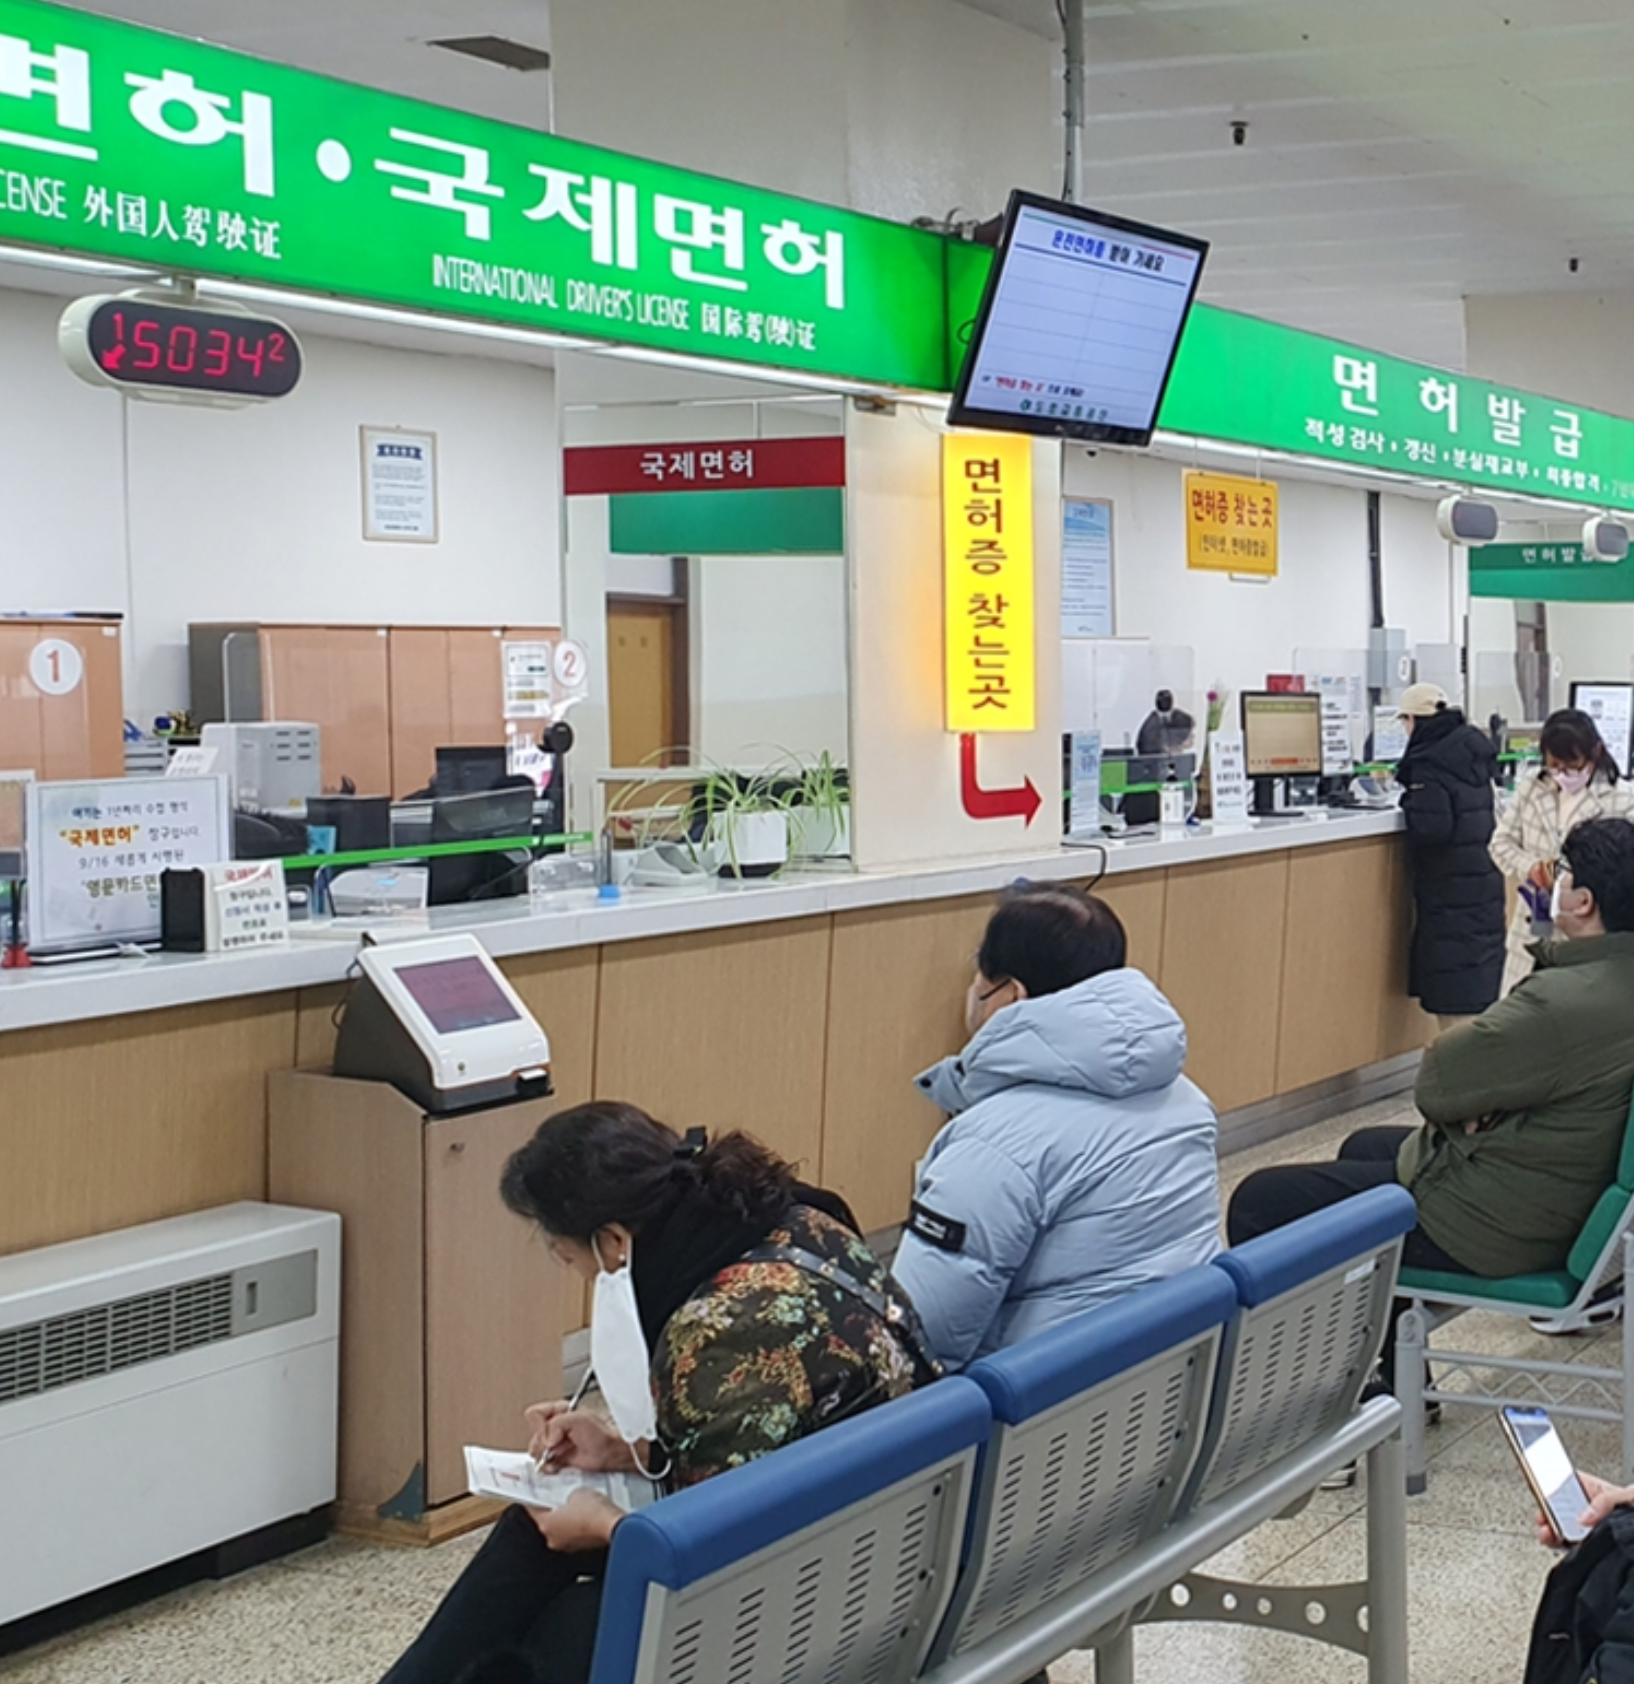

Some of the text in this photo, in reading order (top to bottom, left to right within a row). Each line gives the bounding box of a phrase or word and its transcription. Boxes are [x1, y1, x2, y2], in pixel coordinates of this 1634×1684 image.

[433, 254, 558, 308] INTERNATIONAL
[637, 294, 689, 330] LICENSE
[640, 449, 754, 481] 국제면허
[1404, 438, 1436, 464] 갱신
[963, 457, 1008, 576] 면허증
[1192, 489, 1229, 525] 면허증
[46, 651, 60, 682] 1
[564, 650, 576, 678] 2
